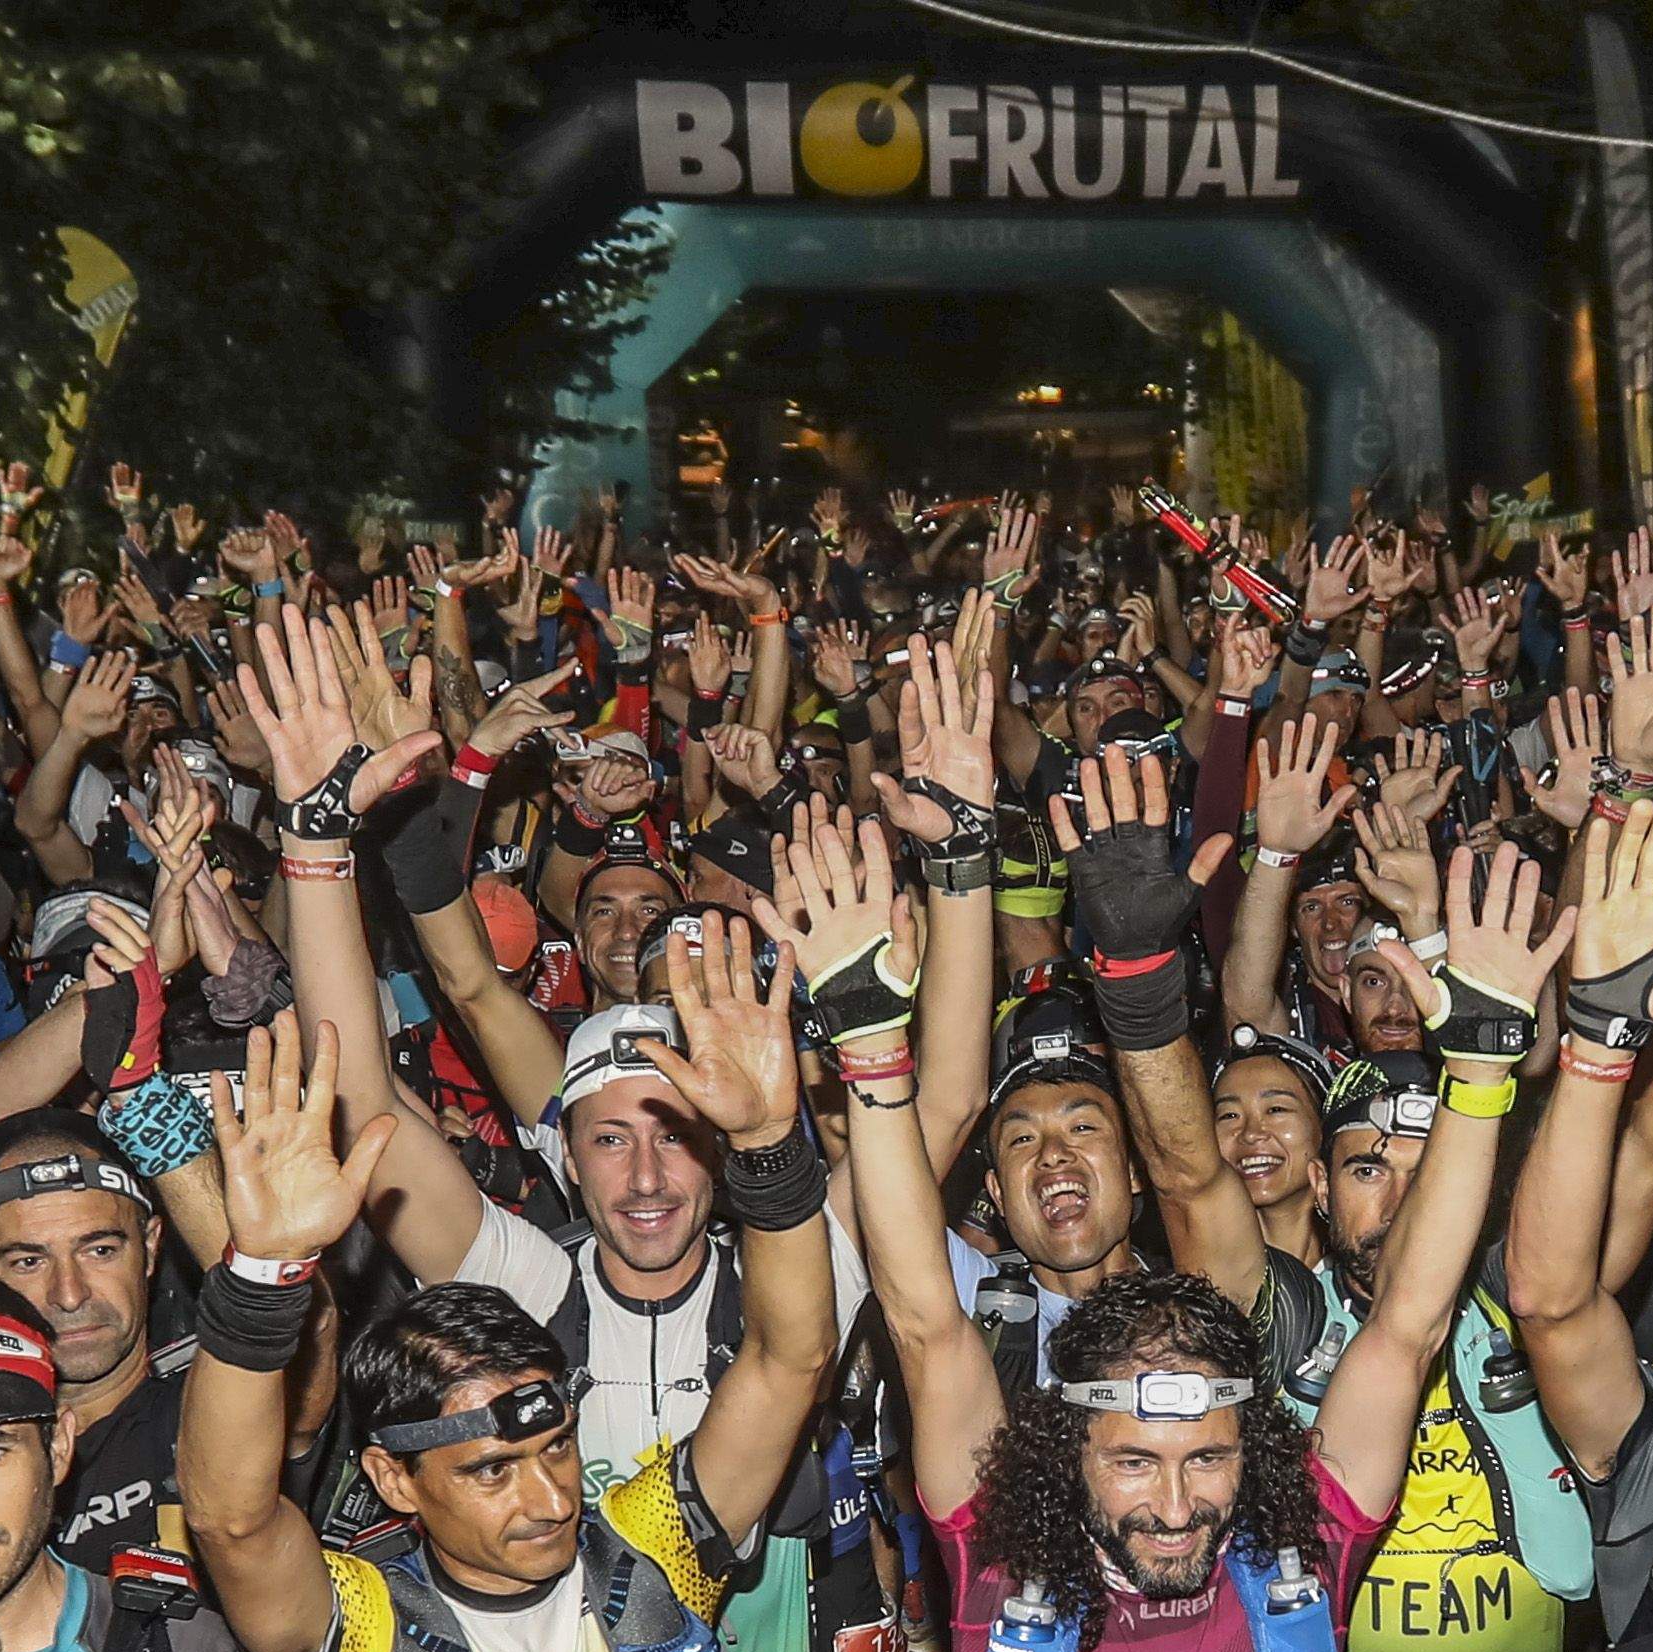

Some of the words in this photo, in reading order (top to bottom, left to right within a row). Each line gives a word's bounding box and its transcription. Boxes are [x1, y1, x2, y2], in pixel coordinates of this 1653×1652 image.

[636, 75, 1300, 198] BIOFRUTAL
[951, 801, 990, 846] LEKI
[1088, 1388, 1117, 1403] PETZL
[58, 1479, 154, 1546] ARP
[1361, 1567, 1513, 1636] TEAM
